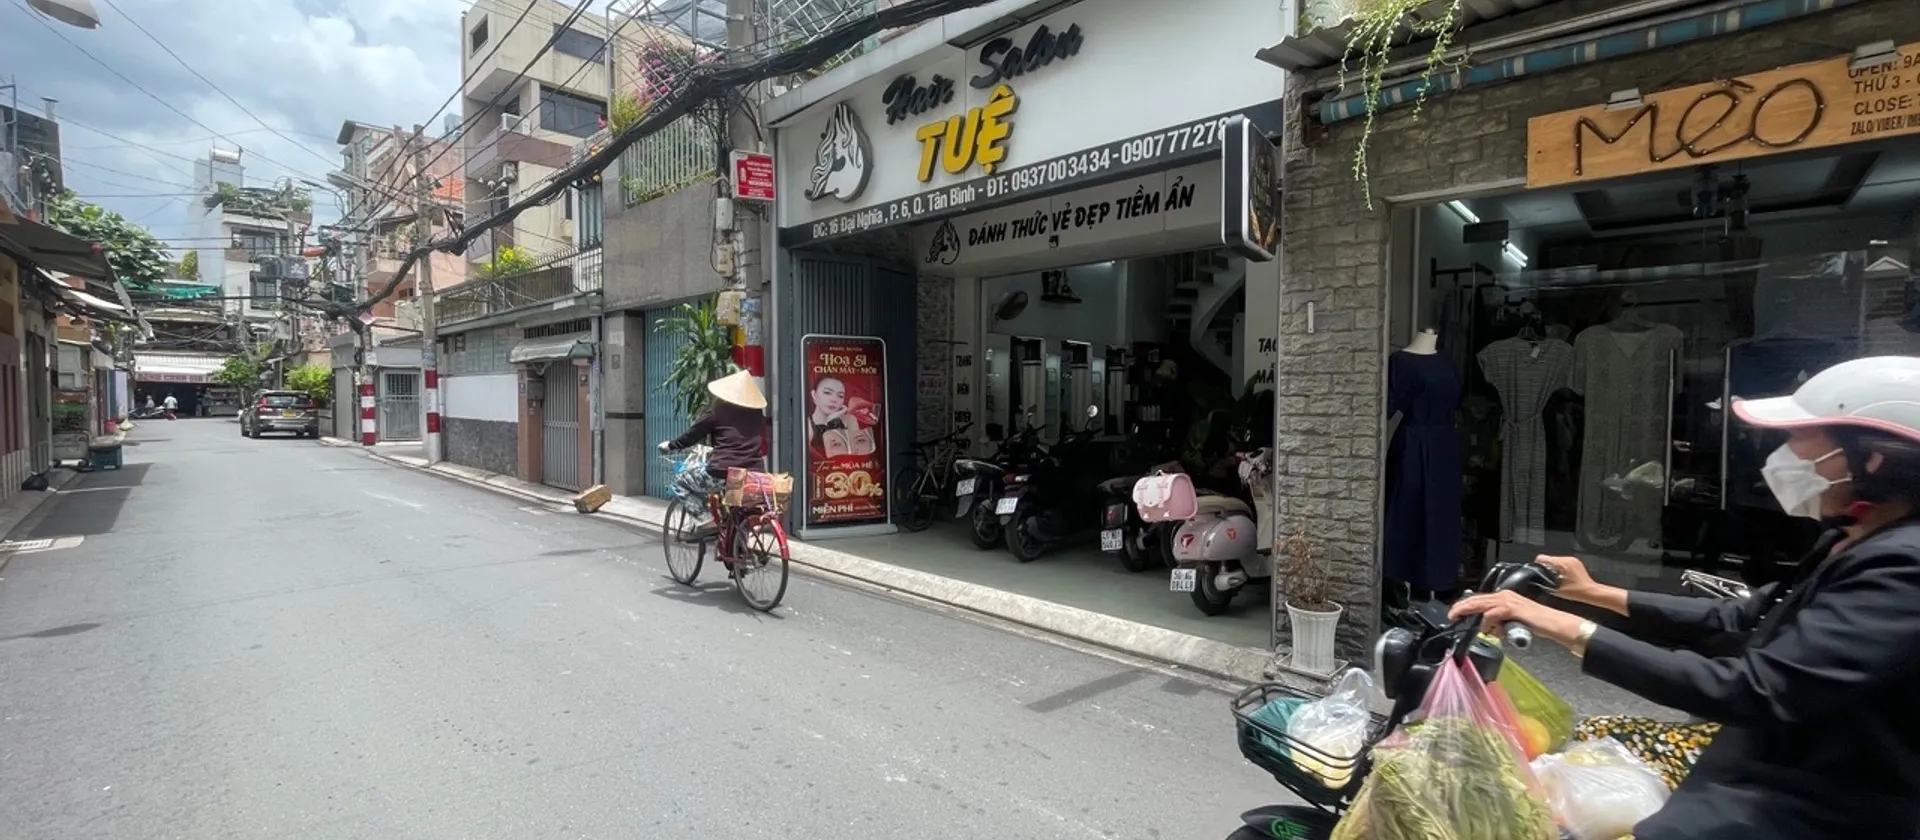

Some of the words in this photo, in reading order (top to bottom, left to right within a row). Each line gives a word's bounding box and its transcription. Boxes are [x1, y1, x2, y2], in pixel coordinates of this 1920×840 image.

[882, 74, 955, 126] Hair
[969, 22, 1084, 90] Salon
[1891, 75, 1901, 90] 3
[1854, 94, 1912, 116] CLOSE:
[916, 84, 1016, 183] TUỆ
[890, 203, 900, 220] P.
[901, 200, 911, 219] 6,
[913, 196, 925, 215] Q.
[927, 191, 948, 211] Tân
[950, 184, 975, 206] Bình
[987, 175, 1009, 197] ĐT:
[968, 221, 1008, 247] ĐÁNH
[1011, 209, 1048, 239] THỨC
[1052, 201, 1072, 232] VẺ
[1075, 205, 1110, 230] ĐẸP
[1116, 184, 1160, 220] TIỀM
[1164, 175, 1196, 211] ẨN
[825, 470, 883, 499] 30%
